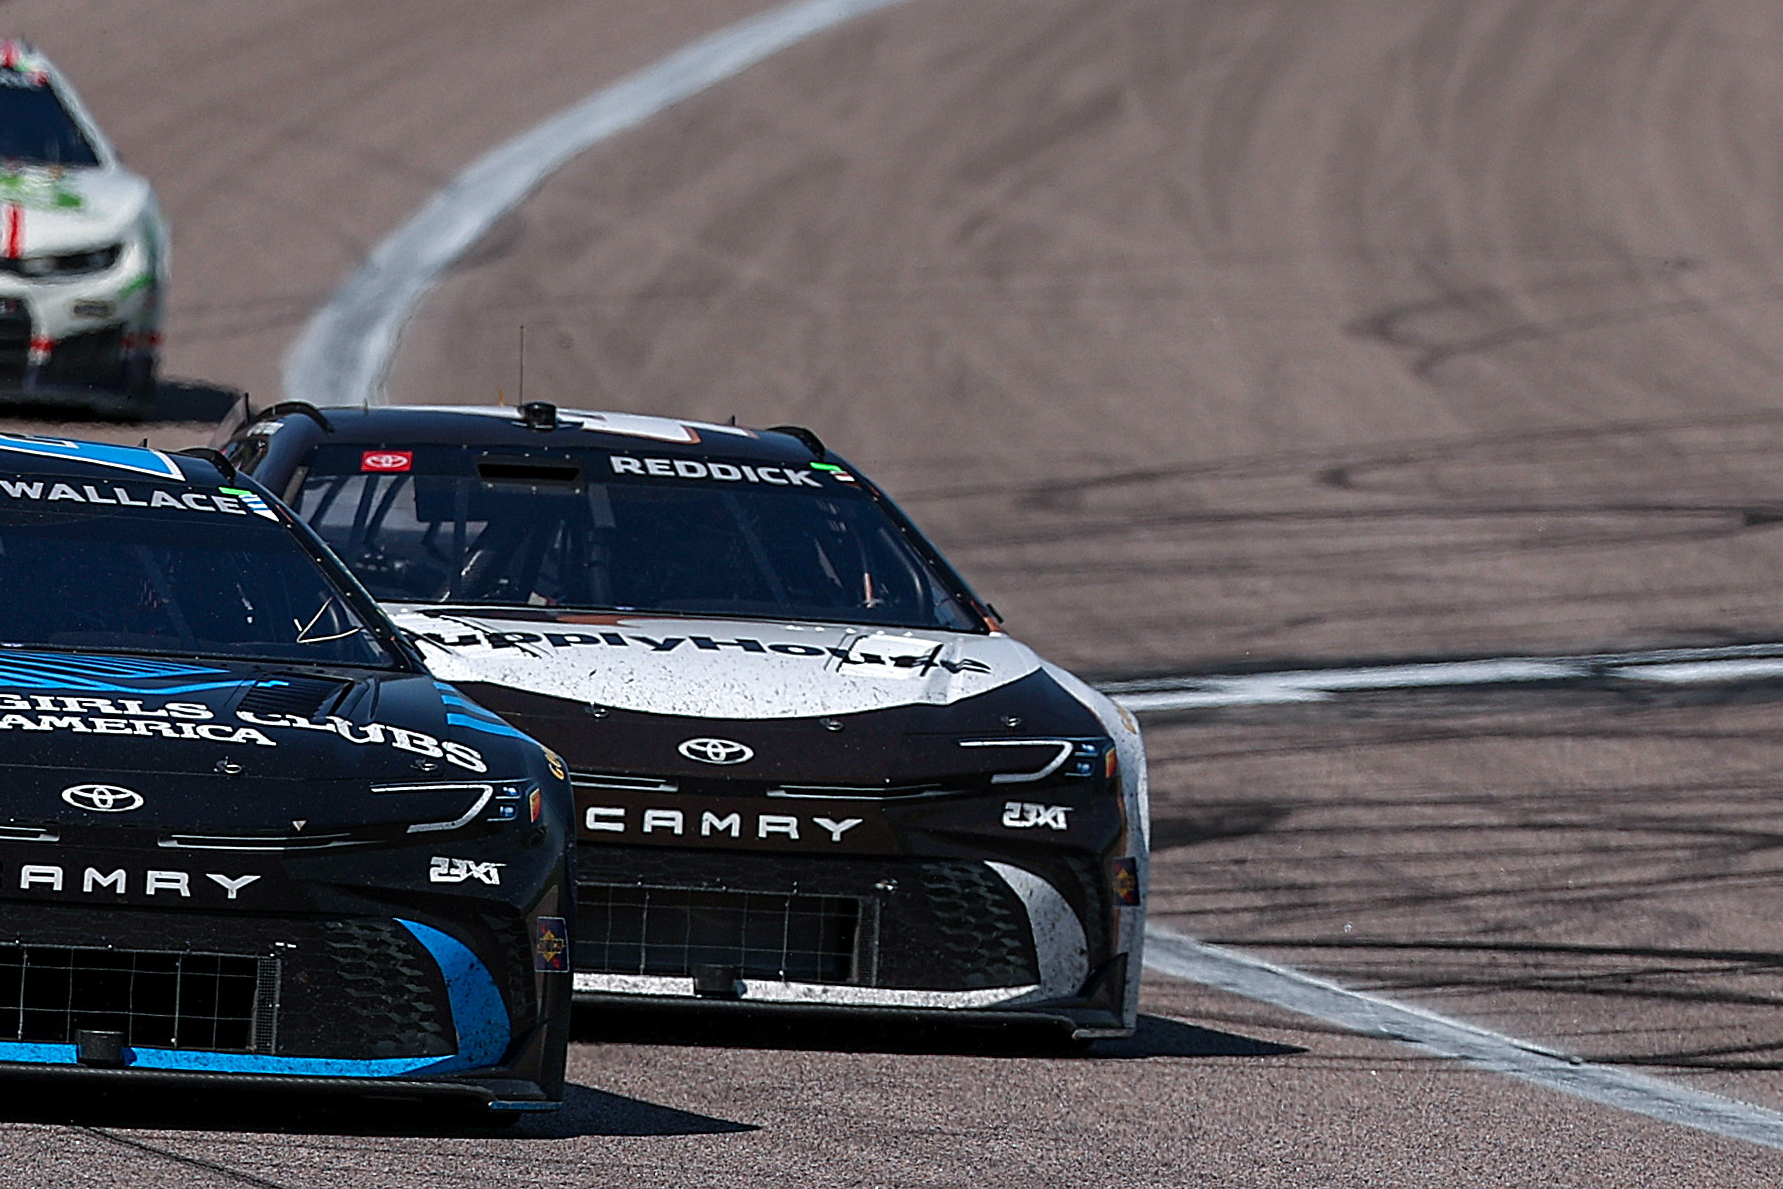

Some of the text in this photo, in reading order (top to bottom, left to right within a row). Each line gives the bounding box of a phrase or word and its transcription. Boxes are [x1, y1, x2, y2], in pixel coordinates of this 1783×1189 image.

[609, 455, 823, 488] REDDICK
[235, 710, 489, 774] CLUBS
[585, 806, 863, 842] CAMRY
